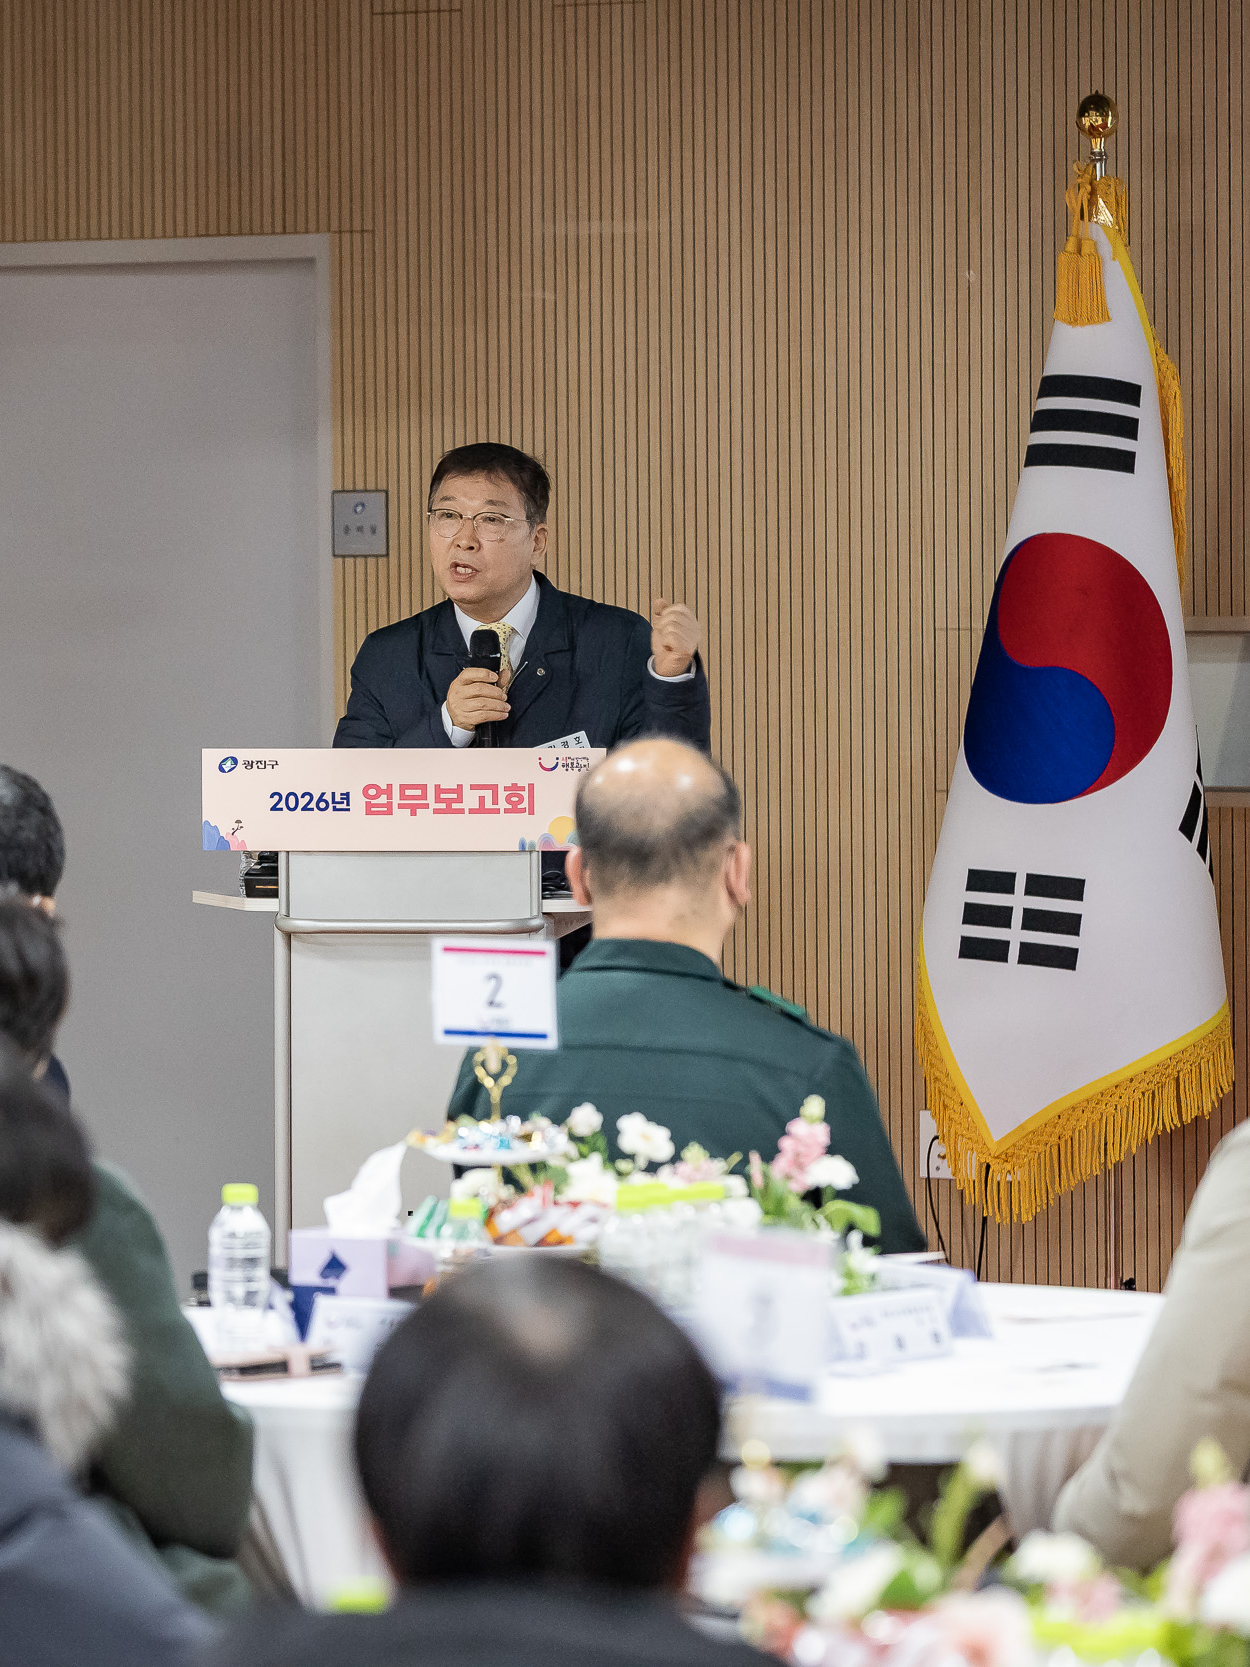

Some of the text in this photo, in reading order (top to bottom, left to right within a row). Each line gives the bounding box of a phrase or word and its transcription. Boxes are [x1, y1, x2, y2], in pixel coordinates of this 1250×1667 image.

[242, 759, 279, 770] 광진구
[269, 782, 535, 817] 2026년 업무보고회
[484, 972, 504, 1008] 2
